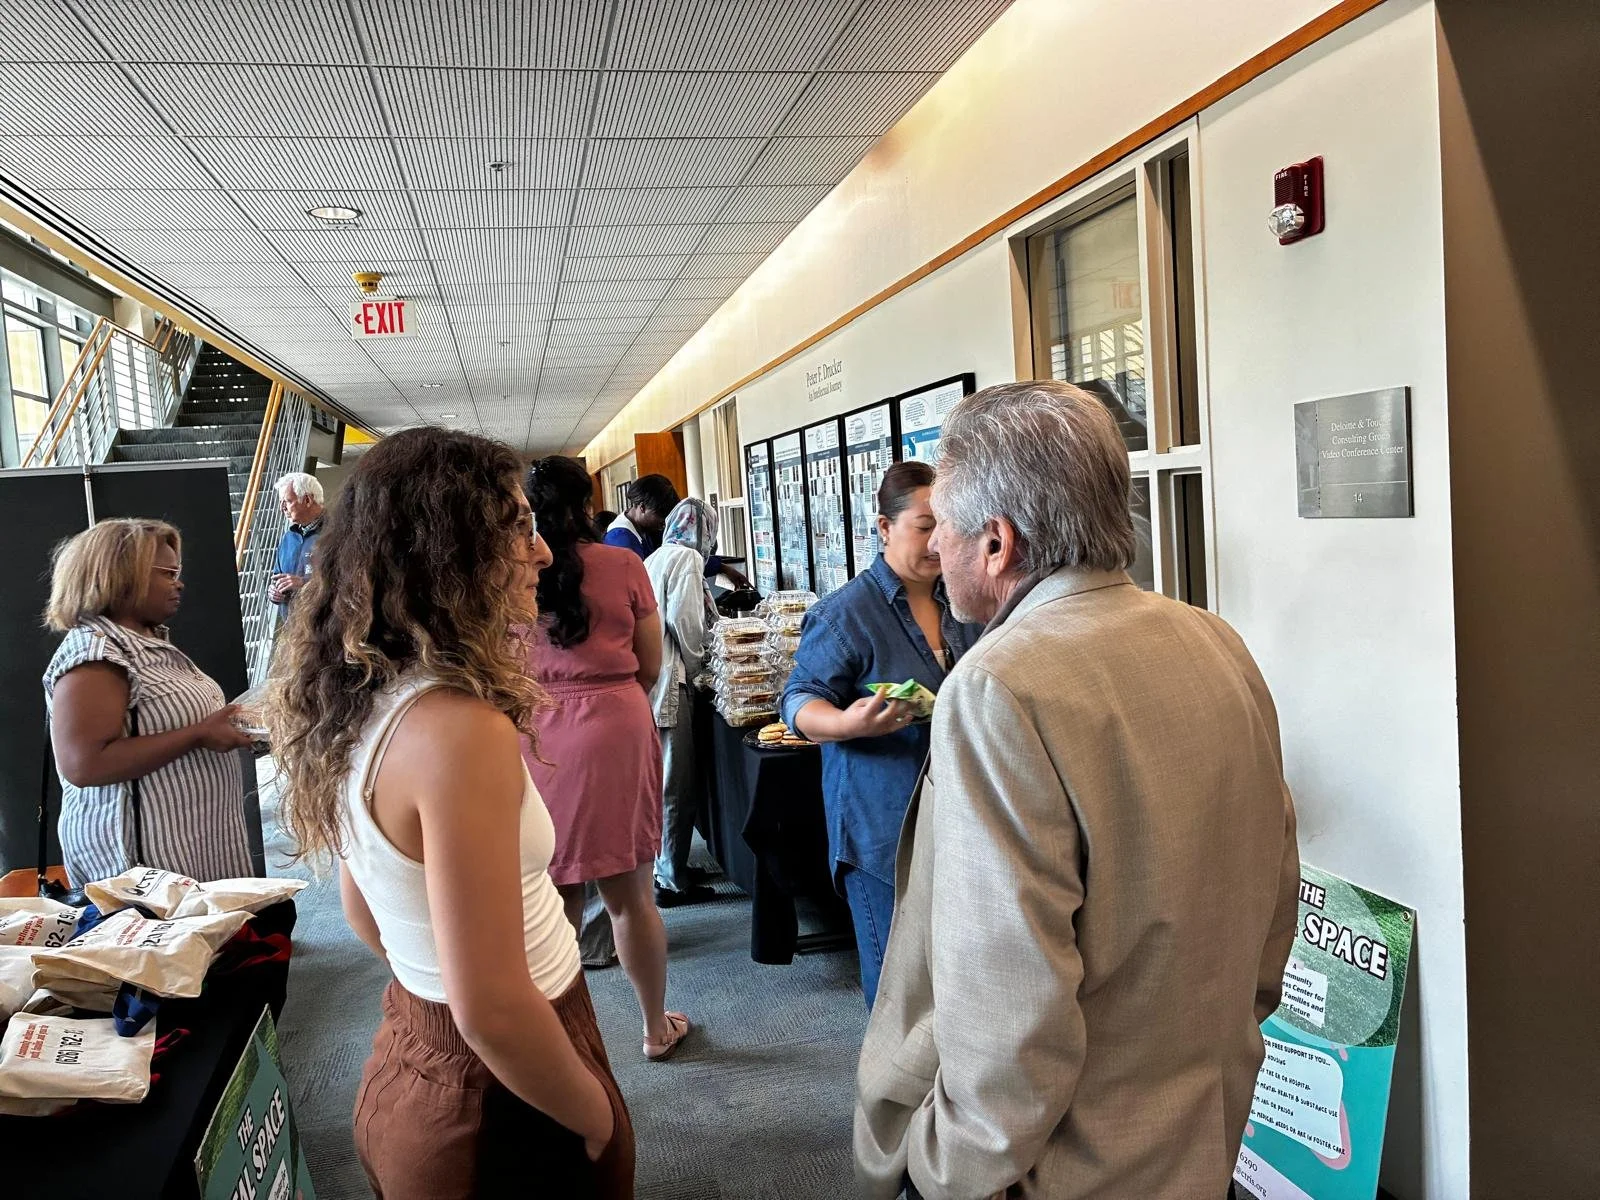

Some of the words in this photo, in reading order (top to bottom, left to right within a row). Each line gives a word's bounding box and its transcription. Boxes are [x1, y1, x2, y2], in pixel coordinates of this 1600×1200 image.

[1275, 170, 1288, 181] FIRE
[362, 302, 405, 334] EXIT
[806, 372, 818, 387] Peter
[823, 358, 842, 380] Drucker
[1331, 421, 1357, 432] Deloitte
[1357, 419, 1365, 430] &
[1332, 433, 1368, 445] Consulting
[1368, 431, 1391, 443] Group
[1321, 449, 1341, 459] Video
[1341, 446, 1379, 458] Conference
[1380, 445, 1404, 456] Center
[1353, 492, 1363, 503] 14
[1299, 879, 1326, 910] THE
[1303, 912, 1389, 981] SPACE
[1292, 962, 1298, 970] A
[1284, 971, 1313, 988] mmunity
[1292, 984, 1315, 998] Center
[1314, 993, 1325, 1002] for
[1284, 991, 1311, 1007] Families
[1310, 1003, 1325, 1014] and
[1290, 1004, 1311, 1019] Future
[1263, 1039, 1272, 1048] OR
[1272, 1042, 1284, 1051] FREE
[1284, 1045, 1308, 1058] SUPPORT
[1267, 1054, 1287, 1066] HOUSING
[1266, 1069, 1275, 1077] THE
[1289, 1077, 1312, 1091] HOSPITAL
[1260, 1082, 1277, 1093] MENTAL
[1277, 1088, 1295, 1100] HEALTH
[1300, 1098, 1328, 1113] SUBSTANCE
[1328, 1109, 1338, 1118] USE
[1277, 1105, 1294, 1117] PRISON
[237, 1103, 254, 1156] THE
[252, 1083, 286, 1183] SPACE
[1256, 1111, 1275, 1123] MEDICAL
[1275, 1119, 1289, 1131] NEEDS
[1313, 1136, 1332, 1150] FOSTER
[1332, 1145, 1346, 1156] CARE
